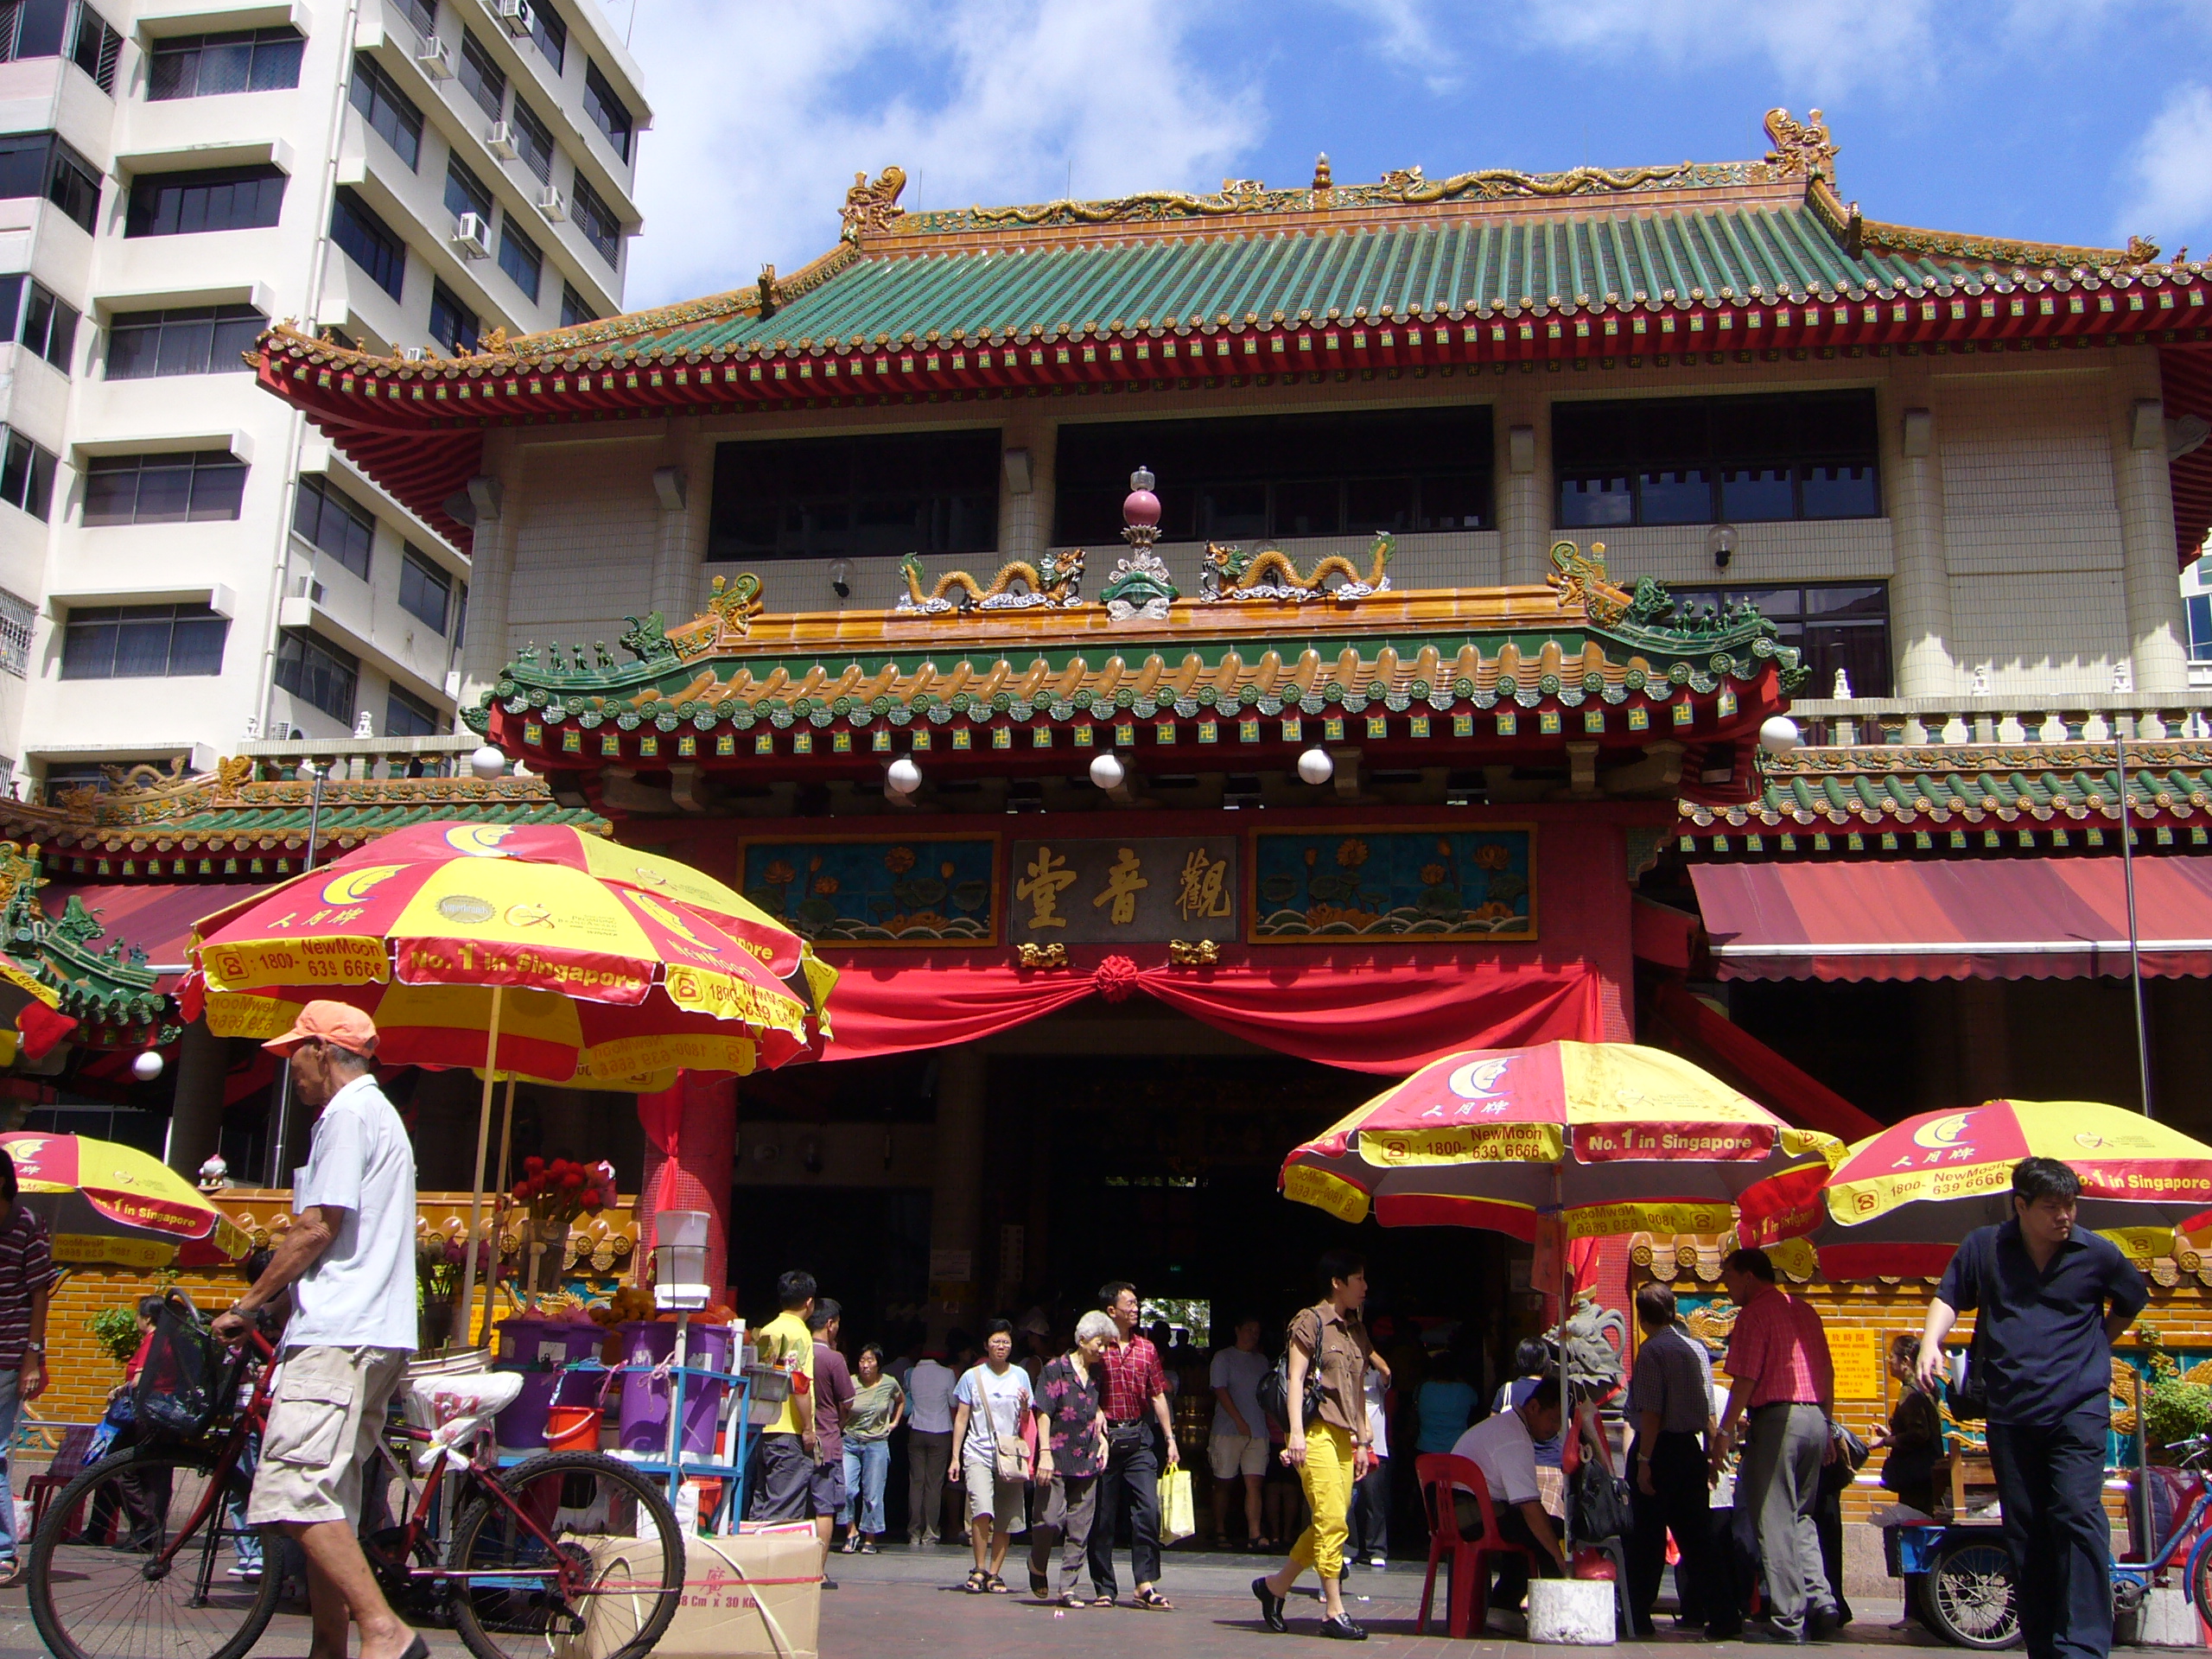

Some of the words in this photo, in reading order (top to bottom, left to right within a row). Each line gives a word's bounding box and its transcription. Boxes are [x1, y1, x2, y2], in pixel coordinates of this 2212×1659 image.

[301, 938, 381, 957] NewMoon
[308, 960, 338, 976] 639
[410, 950, 452, 969] No.
[458, 943, 474, 970] 1
[484, 952, 507, 972] in
[516, 953, 641, 990] Singapore
[1421, 1100, 1510, 1117] 人月牌
[1471, 1126, 1542, 1141] NewMoon
[1589, 1136, 1618, 1151] No.
[1621, 1128, 1633, 1149] 1
[1638, 1135, 1656, 1148] in
[1662, 1134, 1752, 1152] Singapore
[1427, 1141, 1467, 1155] 1800-
[1472, 1145, 1498, 1159] 639
[1505, 1143, 1540, 1158] 6666
[1891, 1147, 1975, 1167] 人月牌
[1934, 1161, 2005, 1182] NewMoon
[2074, 1172, 2094, 1186] o.
[2092, 1169, 2106, 1187] 1
[2107, 1174, 2126, 1188] in
[2127, 1174, 2211, 1192] Singapore
[1891, 1180, 1927, 1198] 1800-
[1933, 1183, 1961, 1195] 639
[1966, 1172, 2005, 1188] 6666
[114, 1198, 124, 1213] 1
[124, 1205, 135, 1216] in
[138, 1207, 196, 1228] Singapore
[1826, 1333, 1865, 1342] 放時間
[691, 1595, 707, 1607] Cm
[726, 1597, 739, 1607] 30
